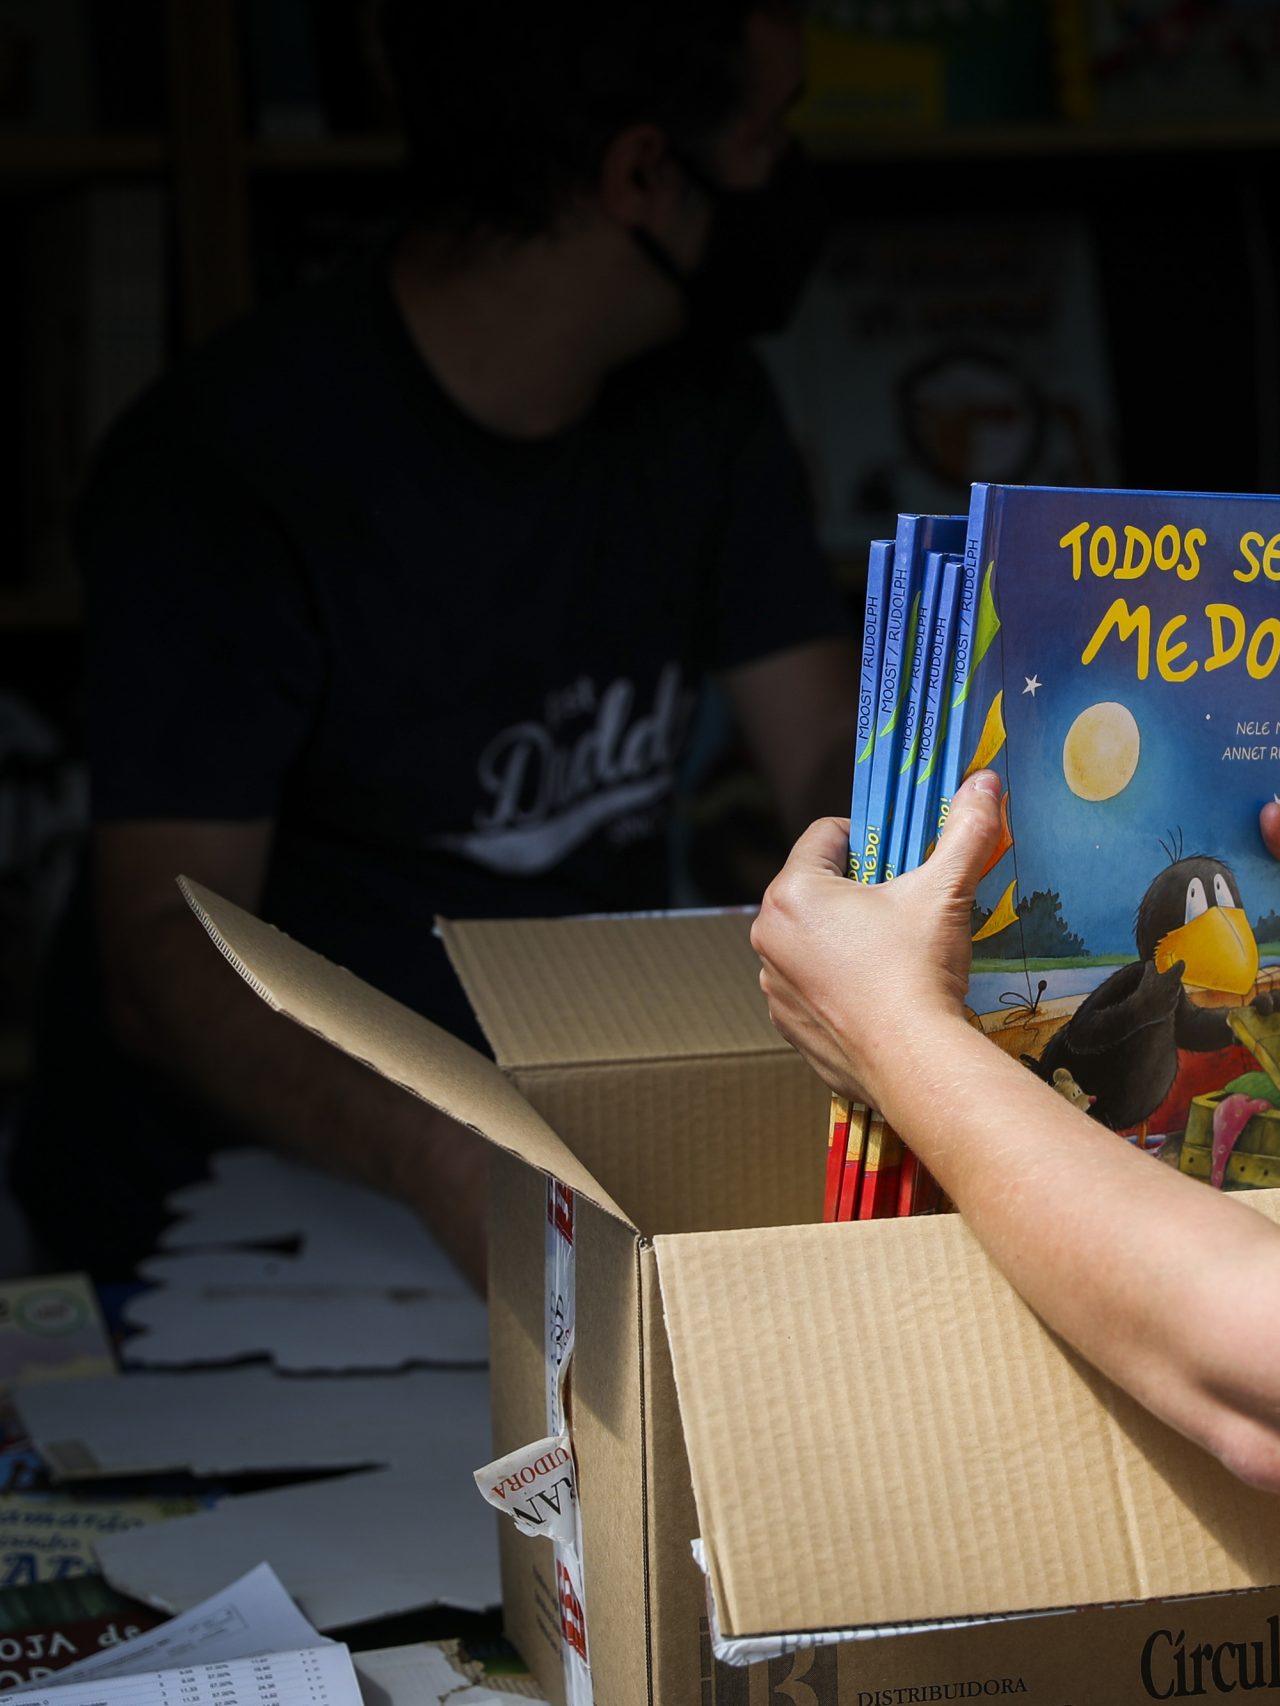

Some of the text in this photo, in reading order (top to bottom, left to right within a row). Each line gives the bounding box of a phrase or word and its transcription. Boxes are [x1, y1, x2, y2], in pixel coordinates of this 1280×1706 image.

[1059, 521, 1206, 581] TODOS
[864, 597, 878, 668] RUDOLPH
[889, 569, 907, 642] RUDOLPH
[954, 634, 968, 684] MOOST
[962, 539, 978, 612] RUDOLPH
[882, 662, 897, 713] MOOST
[902, 700, 916, 750] MOOST
[912, 607, 928, 679] RUDOLPH
[919, 710, 934, 761] MOOST
[929, 618, 946, 690] RUDOLPH
[859, 689, 872, 739] MOOST
[1236, 721, 1270, 735] NELE
[1222, 746, 1267, 760] ANNET
[856, 1677, 1028, 1706] DISTRIBUIDORA
